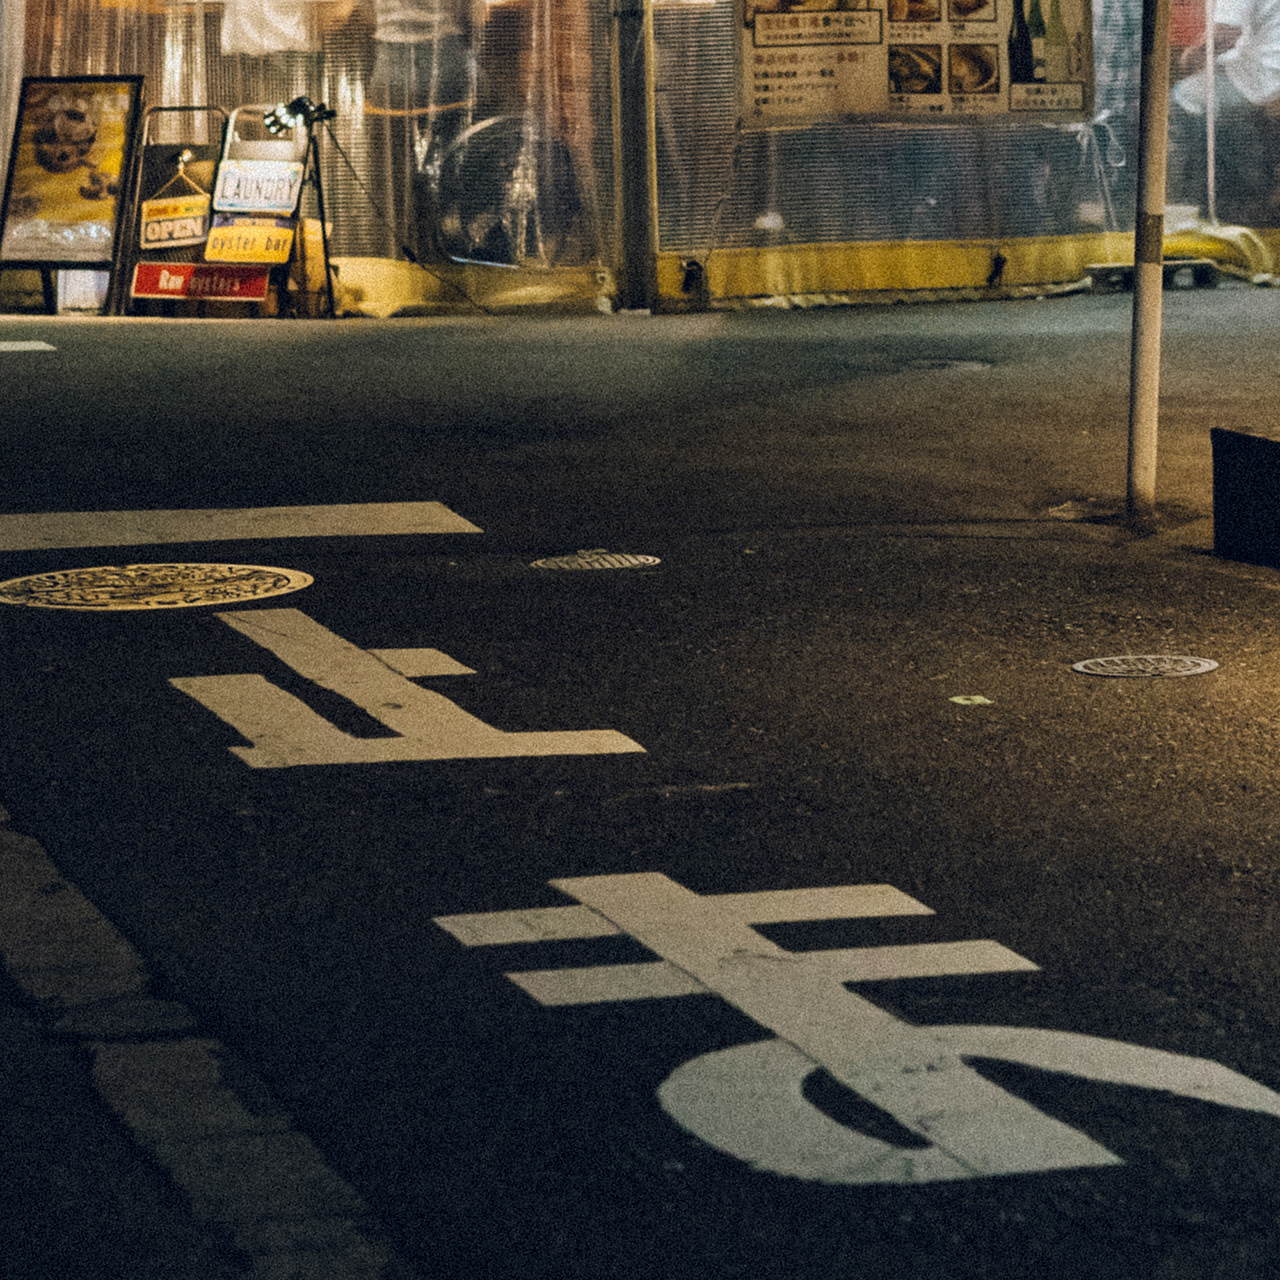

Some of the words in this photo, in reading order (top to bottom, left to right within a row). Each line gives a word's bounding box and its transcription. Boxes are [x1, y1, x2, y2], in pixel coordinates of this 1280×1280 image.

[220, 176, 298, 200] LAUNDRY
[146, 216, 204, 242] OPEN
[211, 234, 257, 252] oyster
[265, 232, 289, 252] bar
[158, 269, 185, 291] Raw
